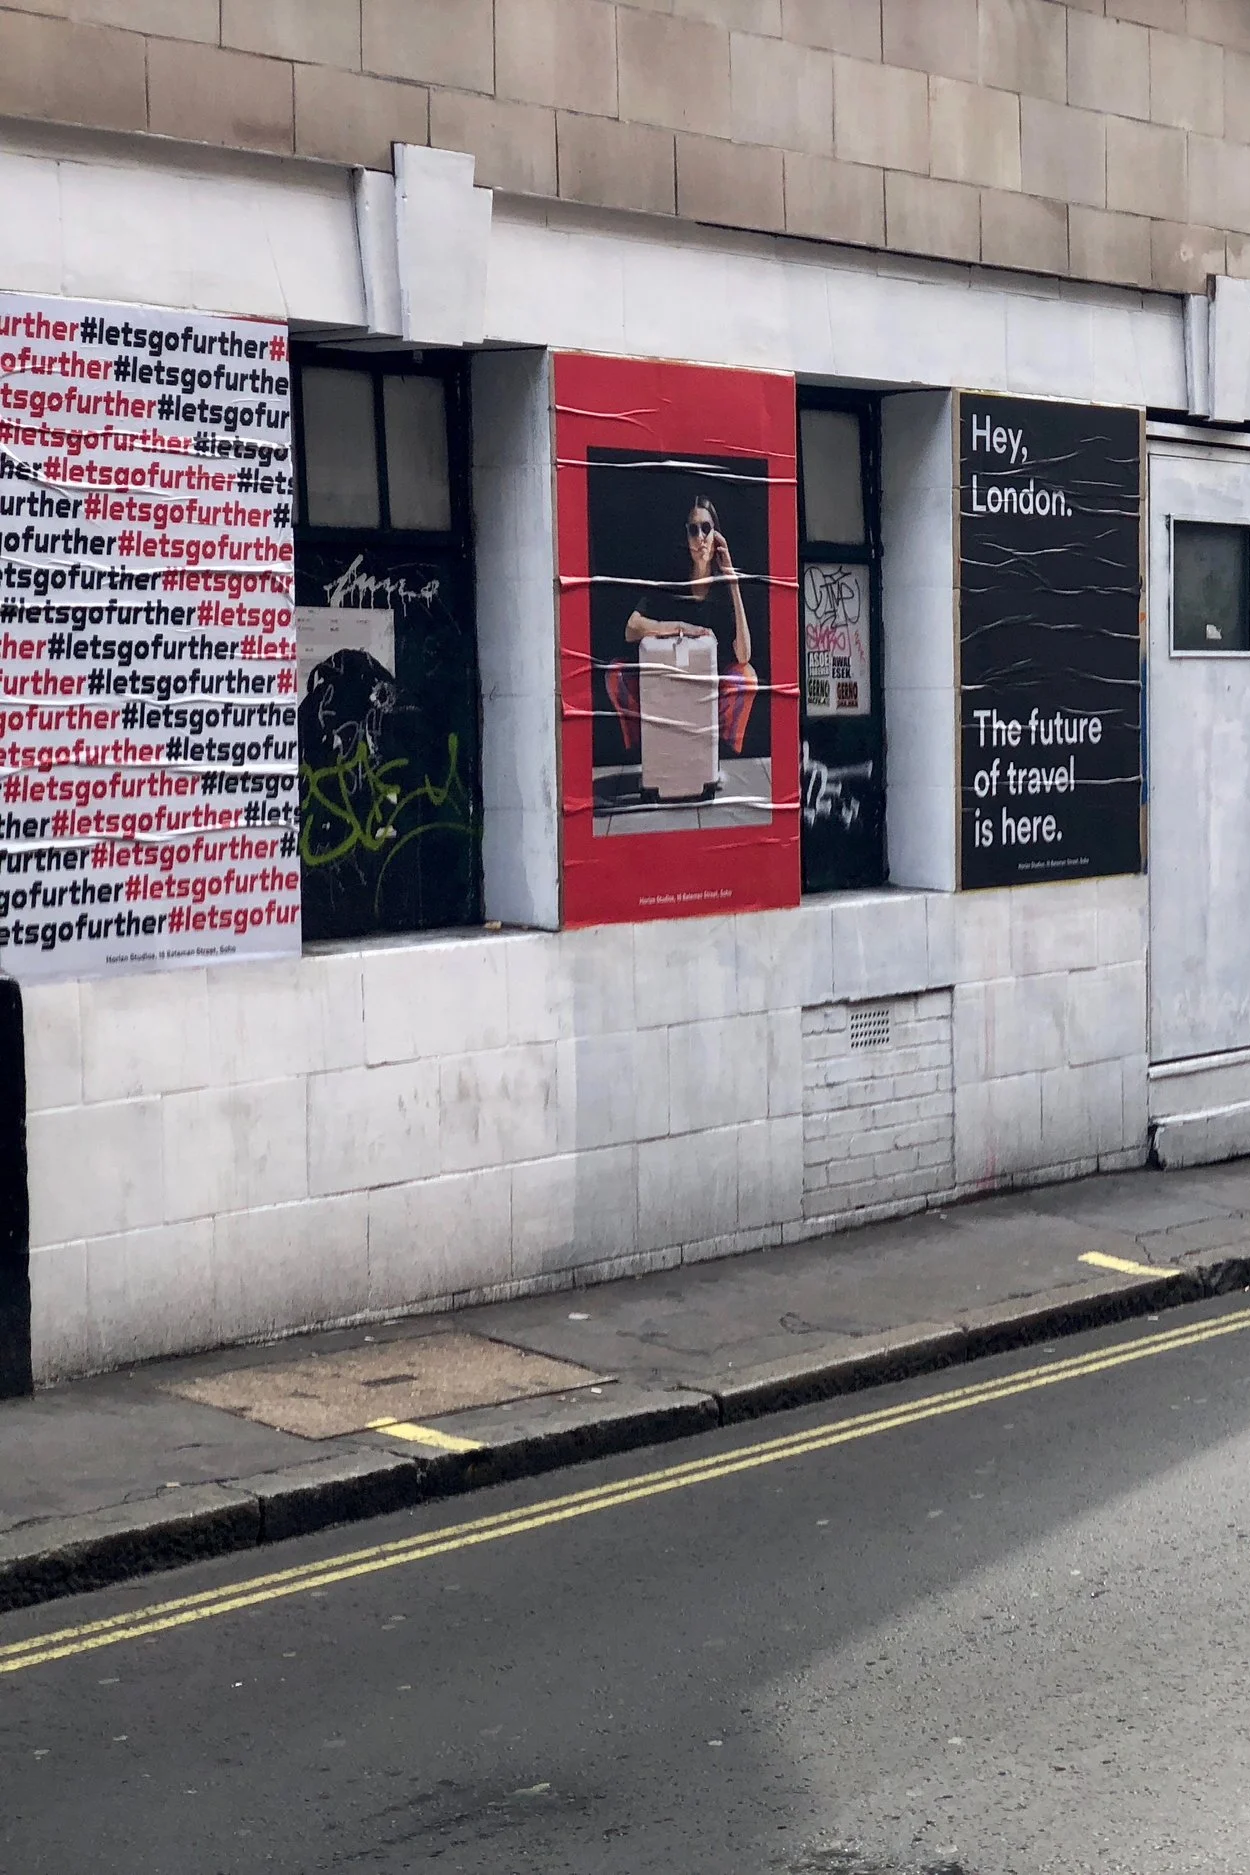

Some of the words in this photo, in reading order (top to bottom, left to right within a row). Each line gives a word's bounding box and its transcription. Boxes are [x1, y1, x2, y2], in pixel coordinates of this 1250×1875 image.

[972, 413, 1028, 464] Hey,
[972, 474, 1073, 517] London.
[973, 708, 1022, 747] The
[1028, 707, 1102, 746] future
[974, 757, 1000, 798] of
[1006, 754, 1075, 796] travel
[974, 808, 993, 848] is
[1001, 806, 1063, 846] here.
